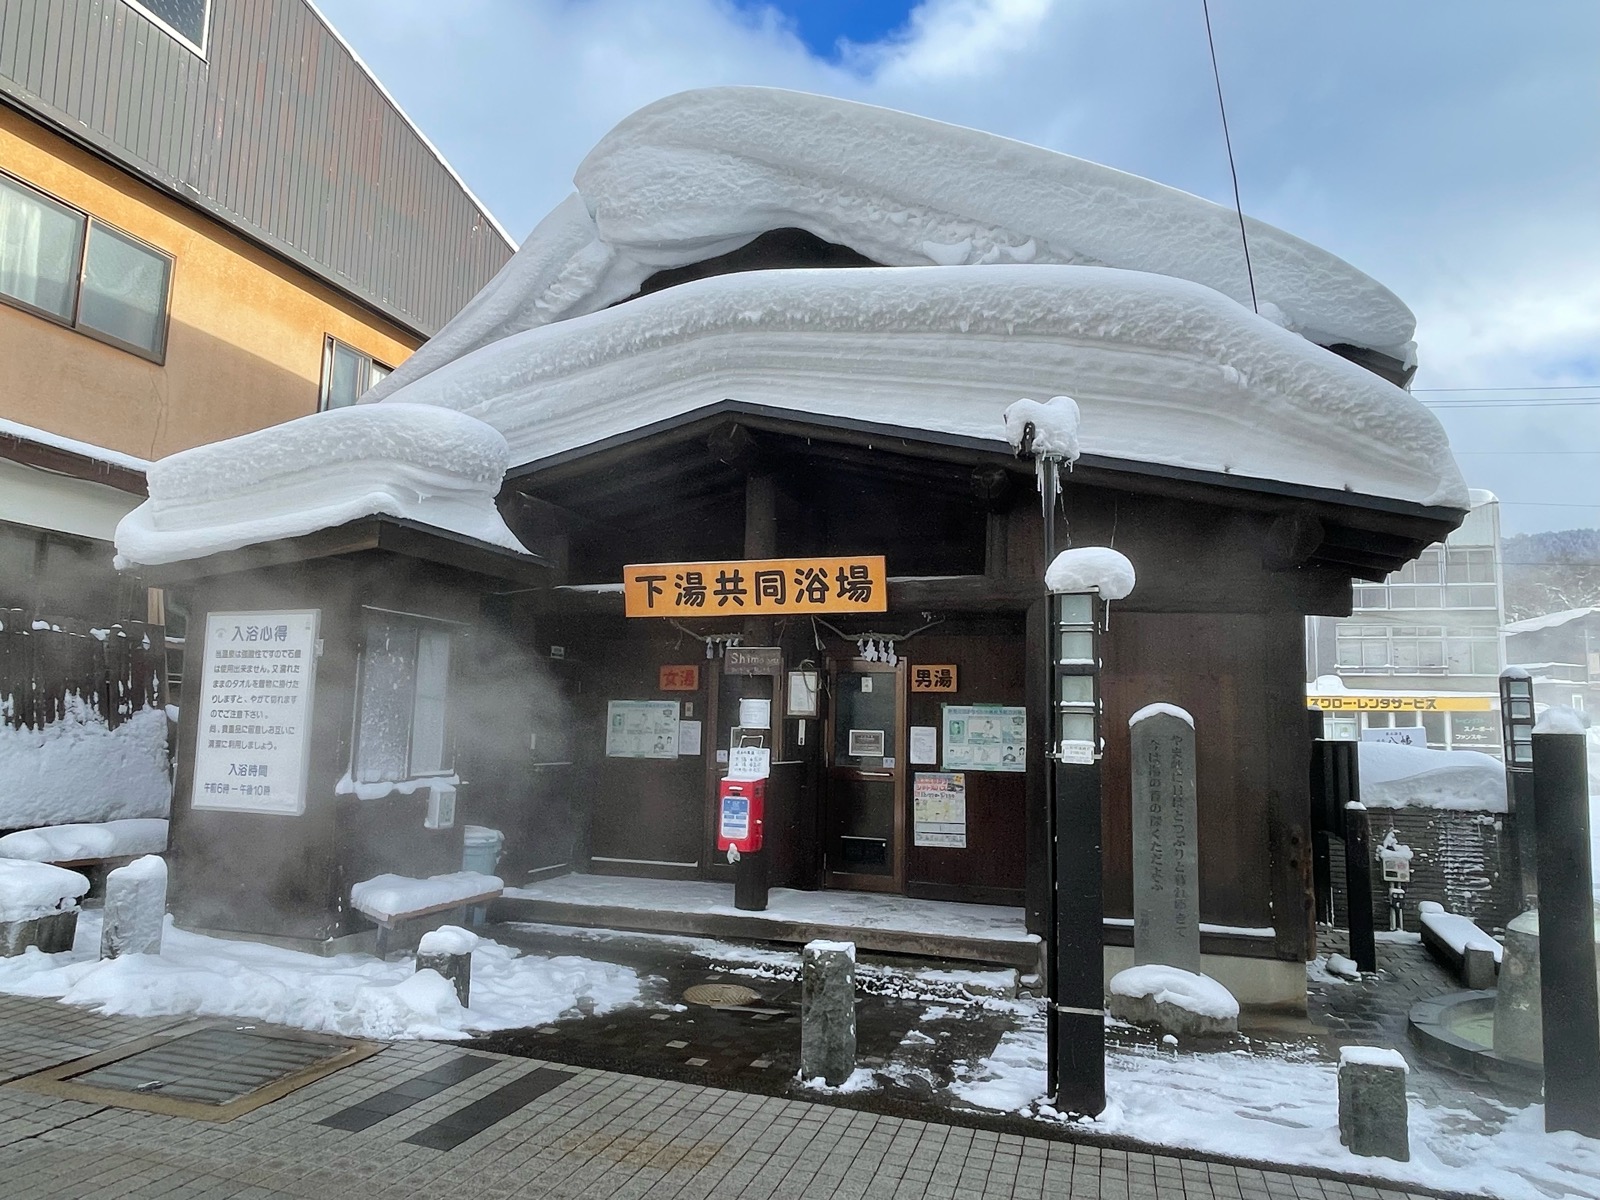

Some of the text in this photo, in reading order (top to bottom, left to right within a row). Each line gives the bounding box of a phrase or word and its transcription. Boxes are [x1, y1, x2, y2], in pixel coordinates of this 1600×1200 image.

[635, 564, 874, 608] 下湯共同浴場
[231, 625, 288, 642] 入浴心得
[663, 669, 696, 688] 女湯
[915, 669, 953, 688] 男湯
[228, 763, 268, 777] 入浴時間
